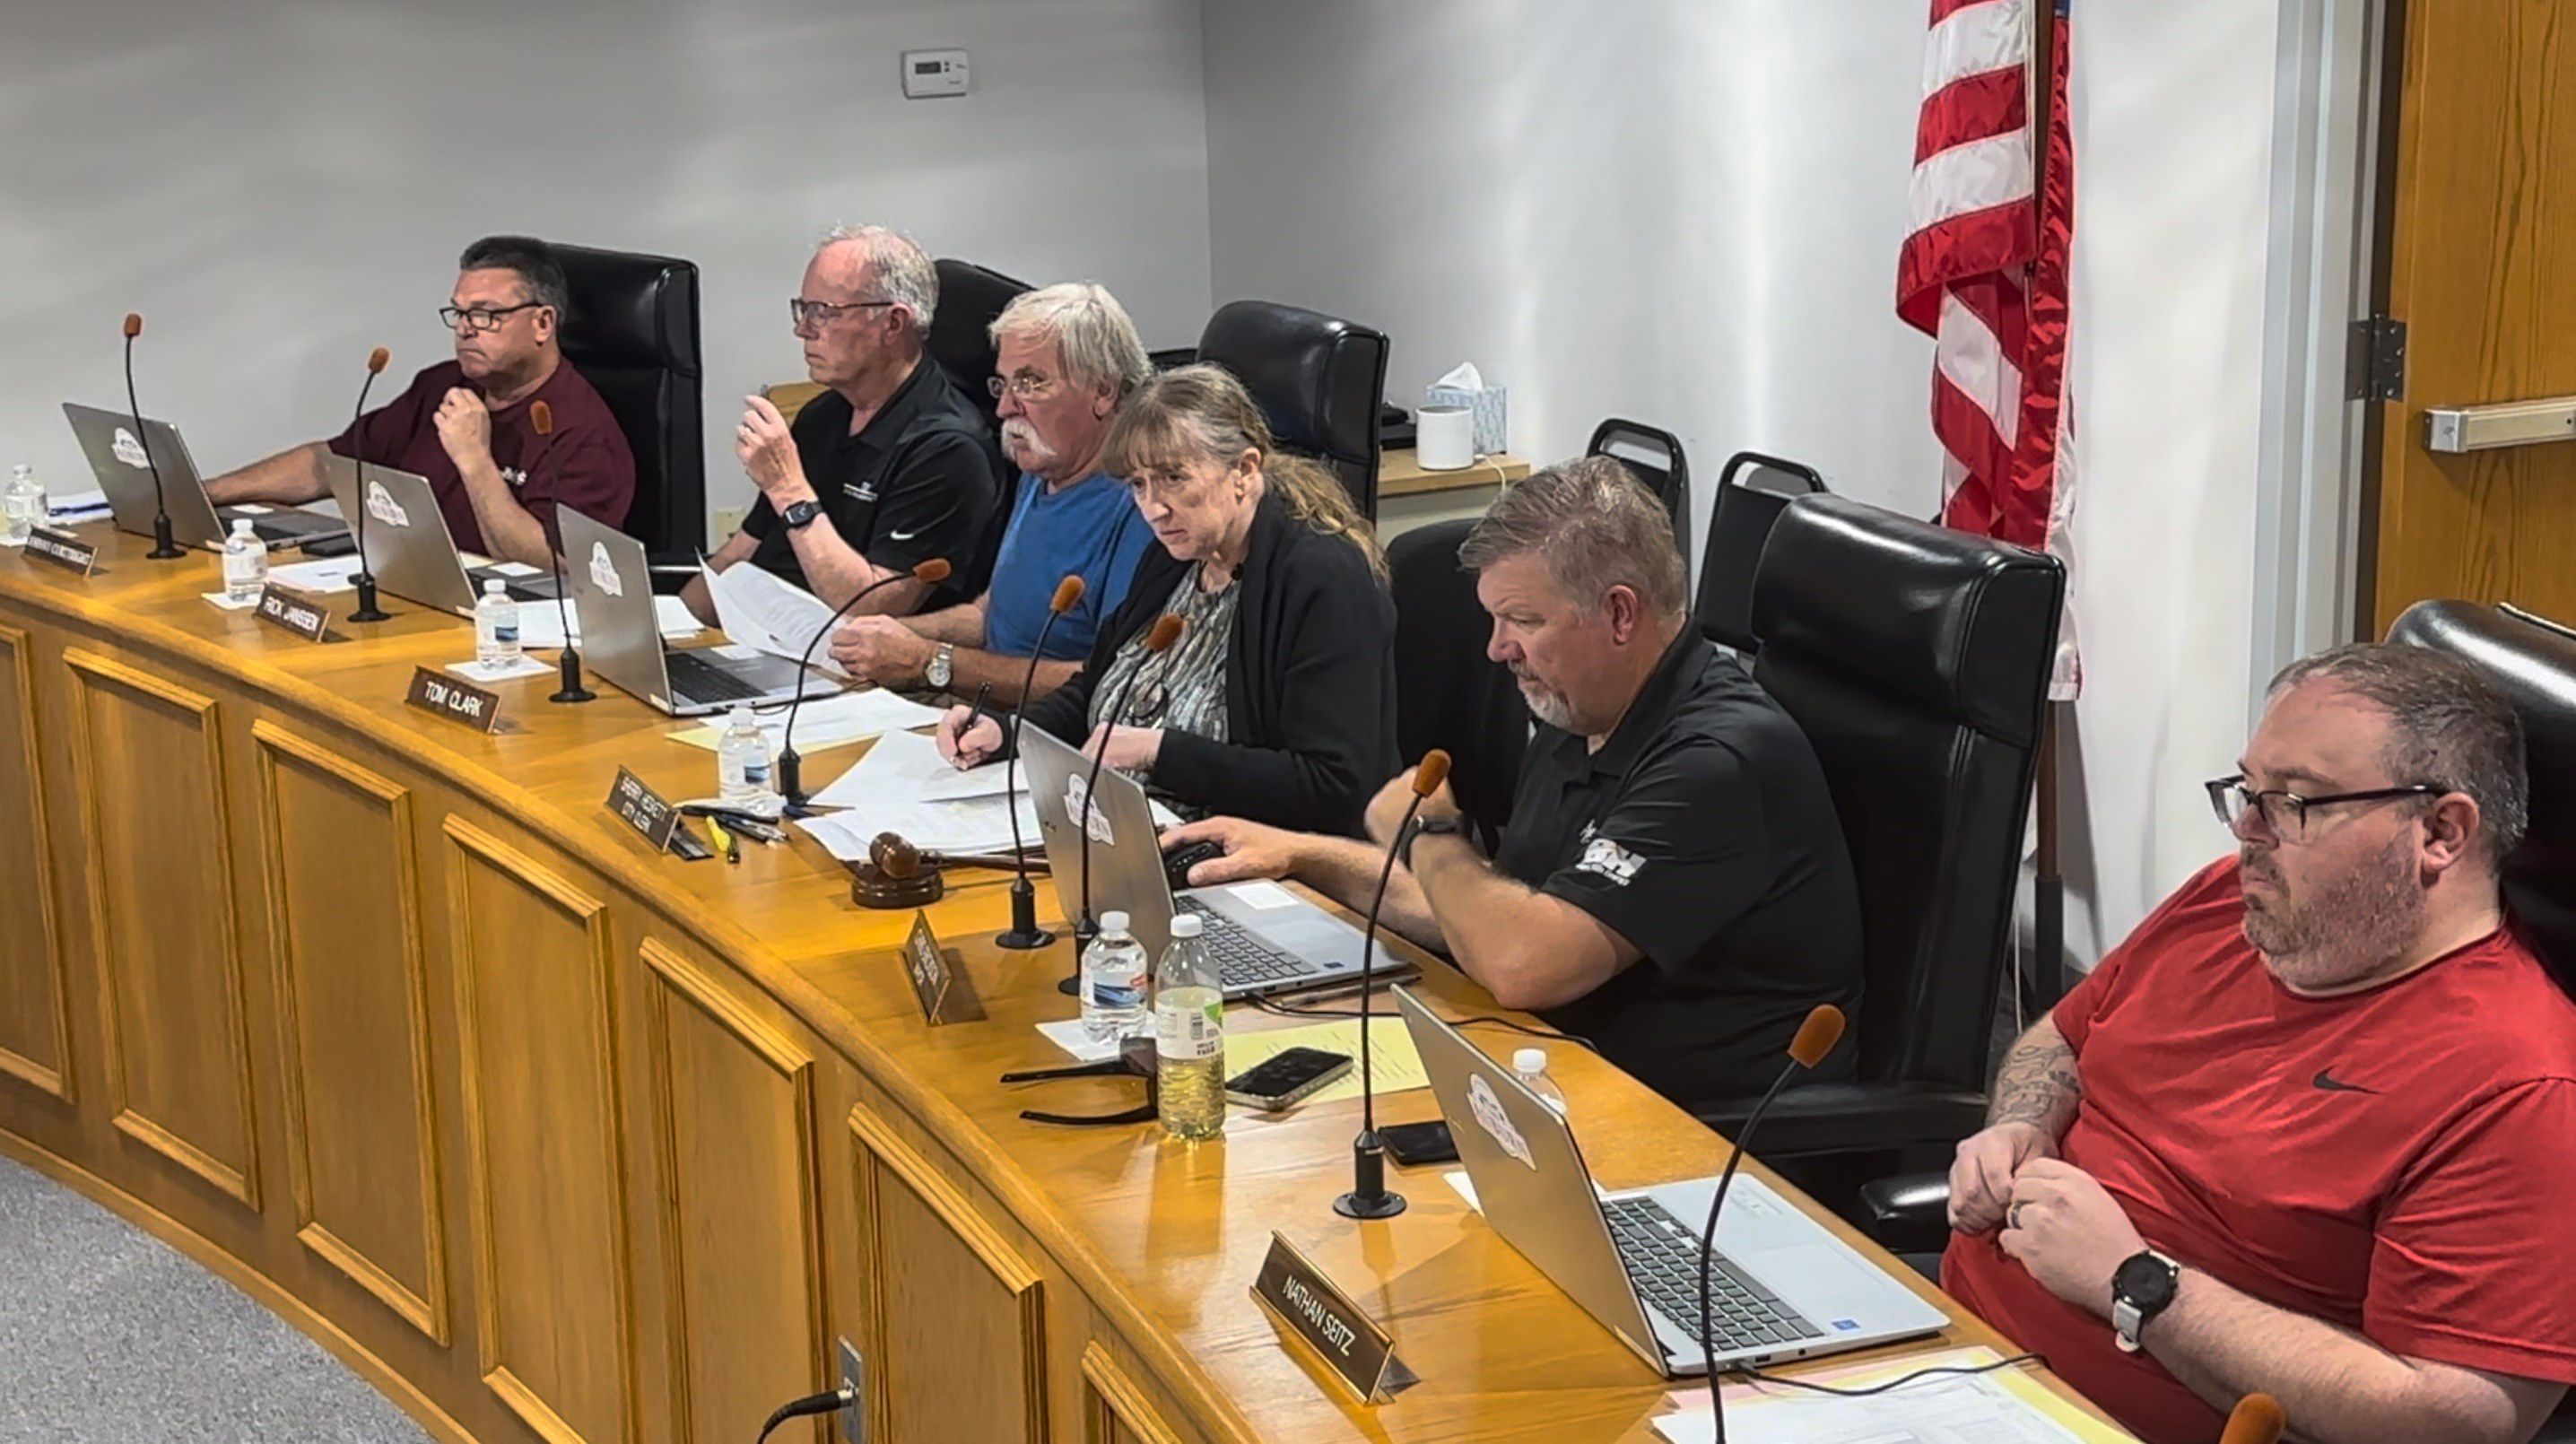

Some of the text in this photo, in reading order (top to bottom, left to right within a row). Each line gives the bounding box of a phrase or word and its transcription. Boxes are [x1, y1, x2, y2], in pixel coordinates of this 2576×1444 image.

[425, 681, 483, 718] TOM CLARK
[1283, 1274, 1355, 1356] NATHAN SEITZ
